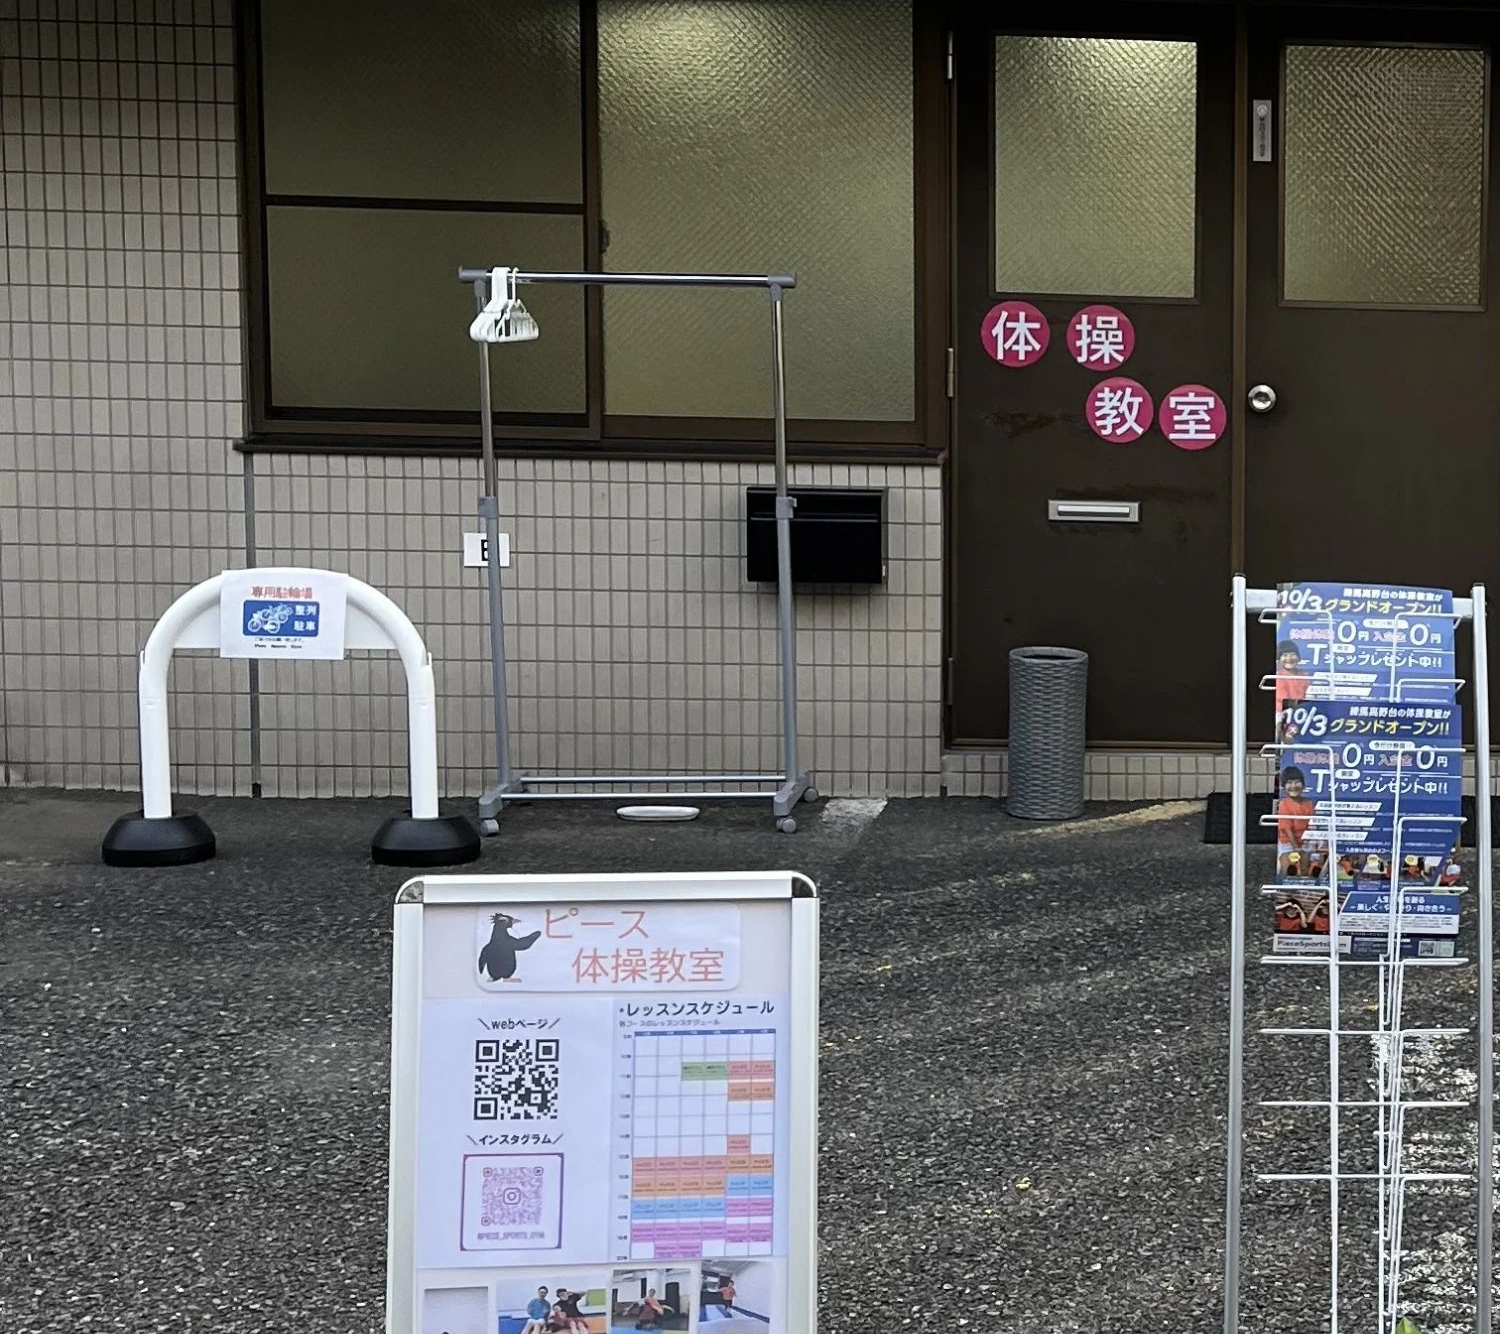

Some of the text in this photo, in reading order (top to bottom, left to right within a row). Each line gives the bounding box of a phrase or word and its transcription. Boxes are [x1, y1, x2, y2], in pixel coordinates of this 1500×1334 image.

[991, 310, 1125, 364] 体操
[1094, 386, 1217, 441] 教室
[1282, 706, 1328, 736] 10/3
[545, 907, 649, 940] ピース
[571, 947, 725, 984] 体操教室
